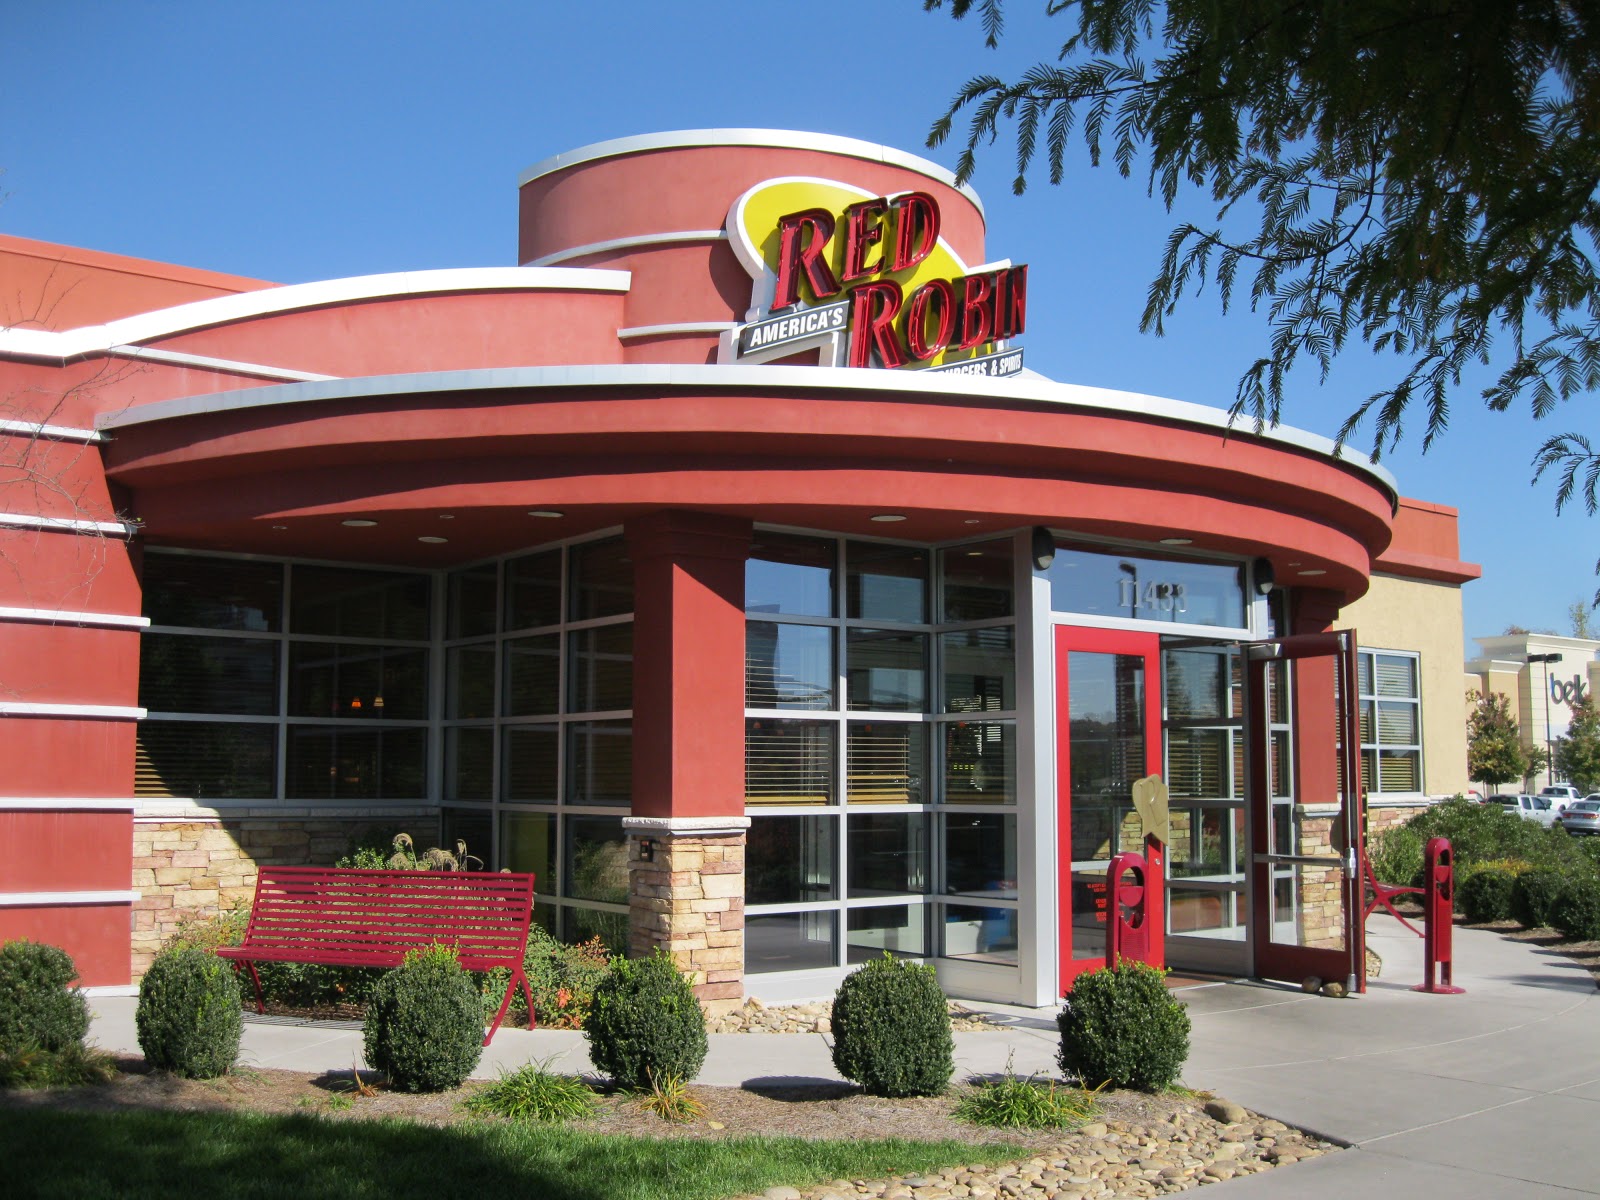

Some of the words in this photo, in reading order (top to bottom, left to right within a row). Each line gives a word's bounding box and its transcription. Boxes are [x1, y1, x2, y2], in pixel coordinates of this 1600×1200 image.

[769, 192, 941, 313] RED
[750, 307, 844, 348] AMERICA'S
[848, 263, 1029, 369] ROBIN
[990, 359, 998, 376] &
[999, 353, 1022, 375] SPIRITS
[1118, 579, 1188, 613] 11433
[1550, 672, 1587, 706] belk
